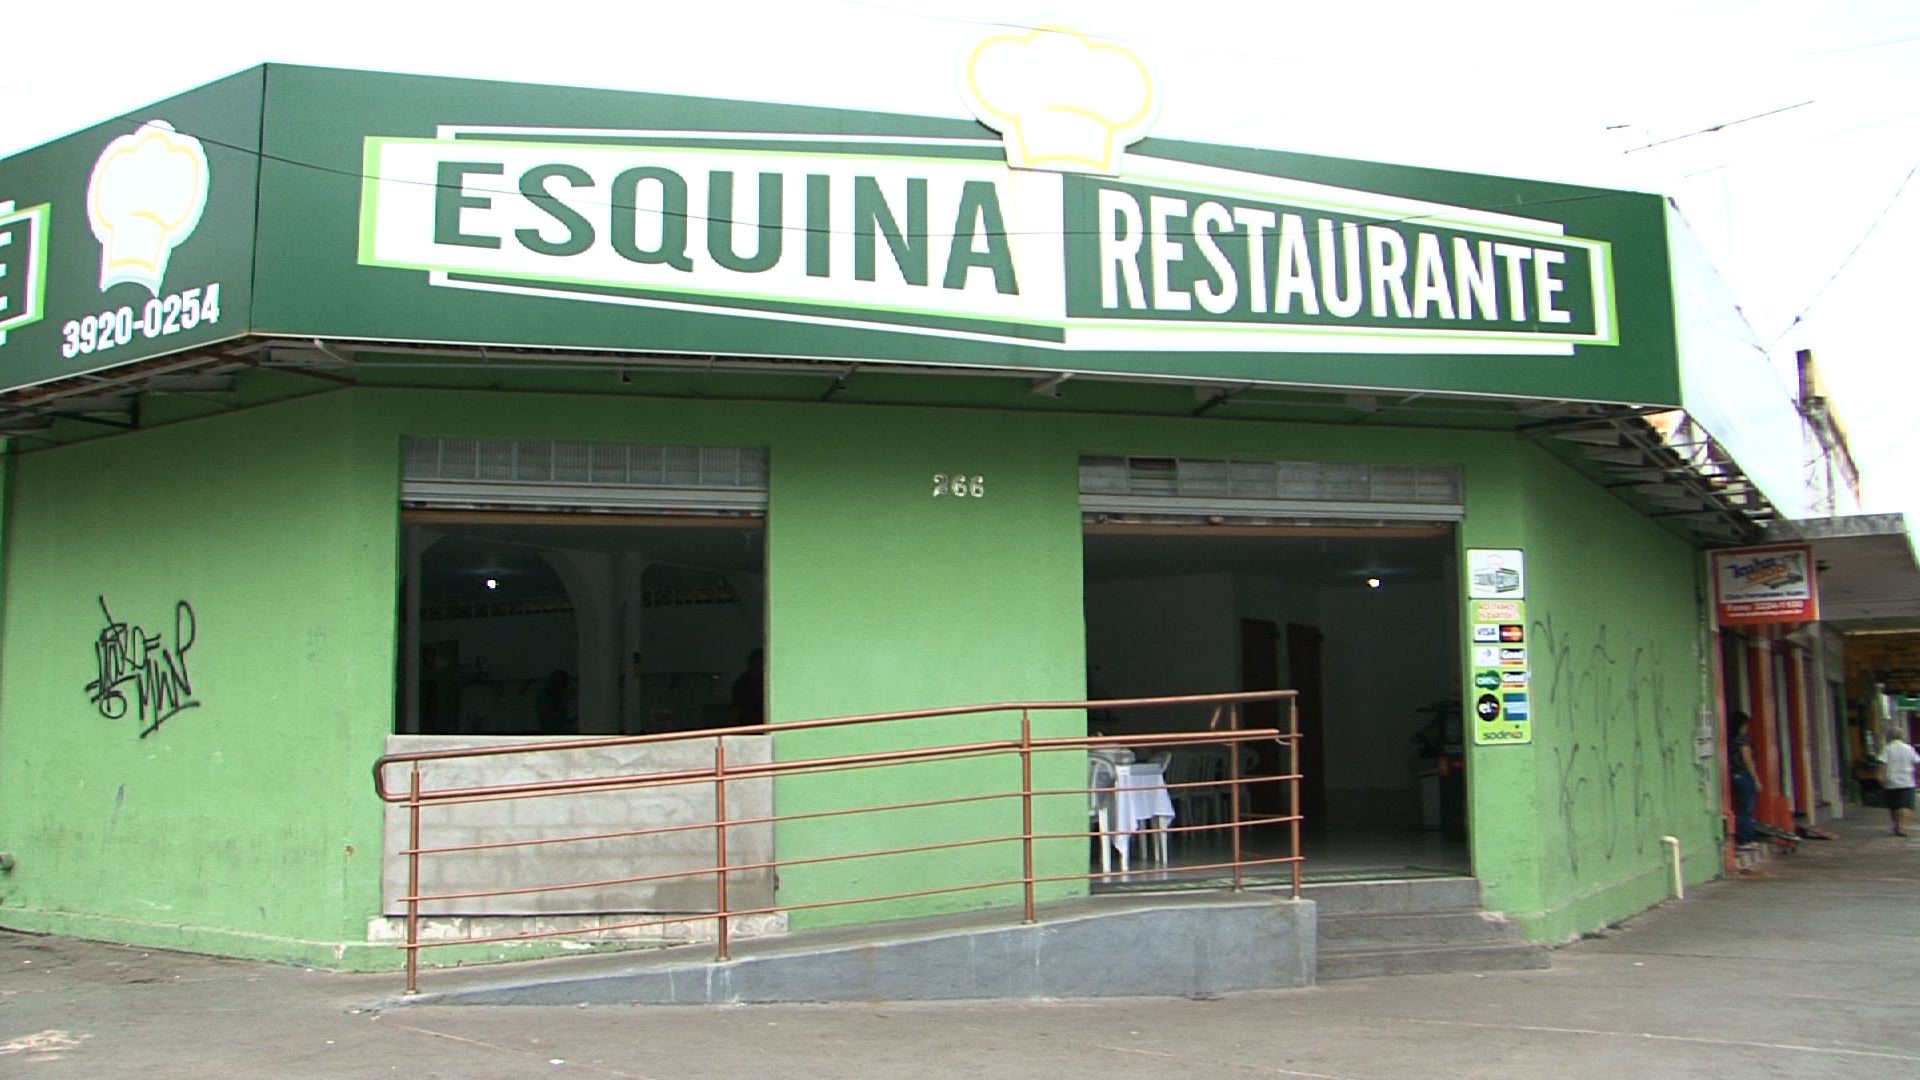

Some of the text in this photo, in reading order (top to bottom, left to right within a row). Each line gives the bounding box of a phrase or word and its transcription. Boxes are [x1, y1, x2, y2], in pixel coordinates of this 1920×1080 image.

[433, 161, 1571, 323] ESQUINA RESTAURANTE
[62, 283, 221, 359] 3920-0254
[932, 473, 984, 498] 266
